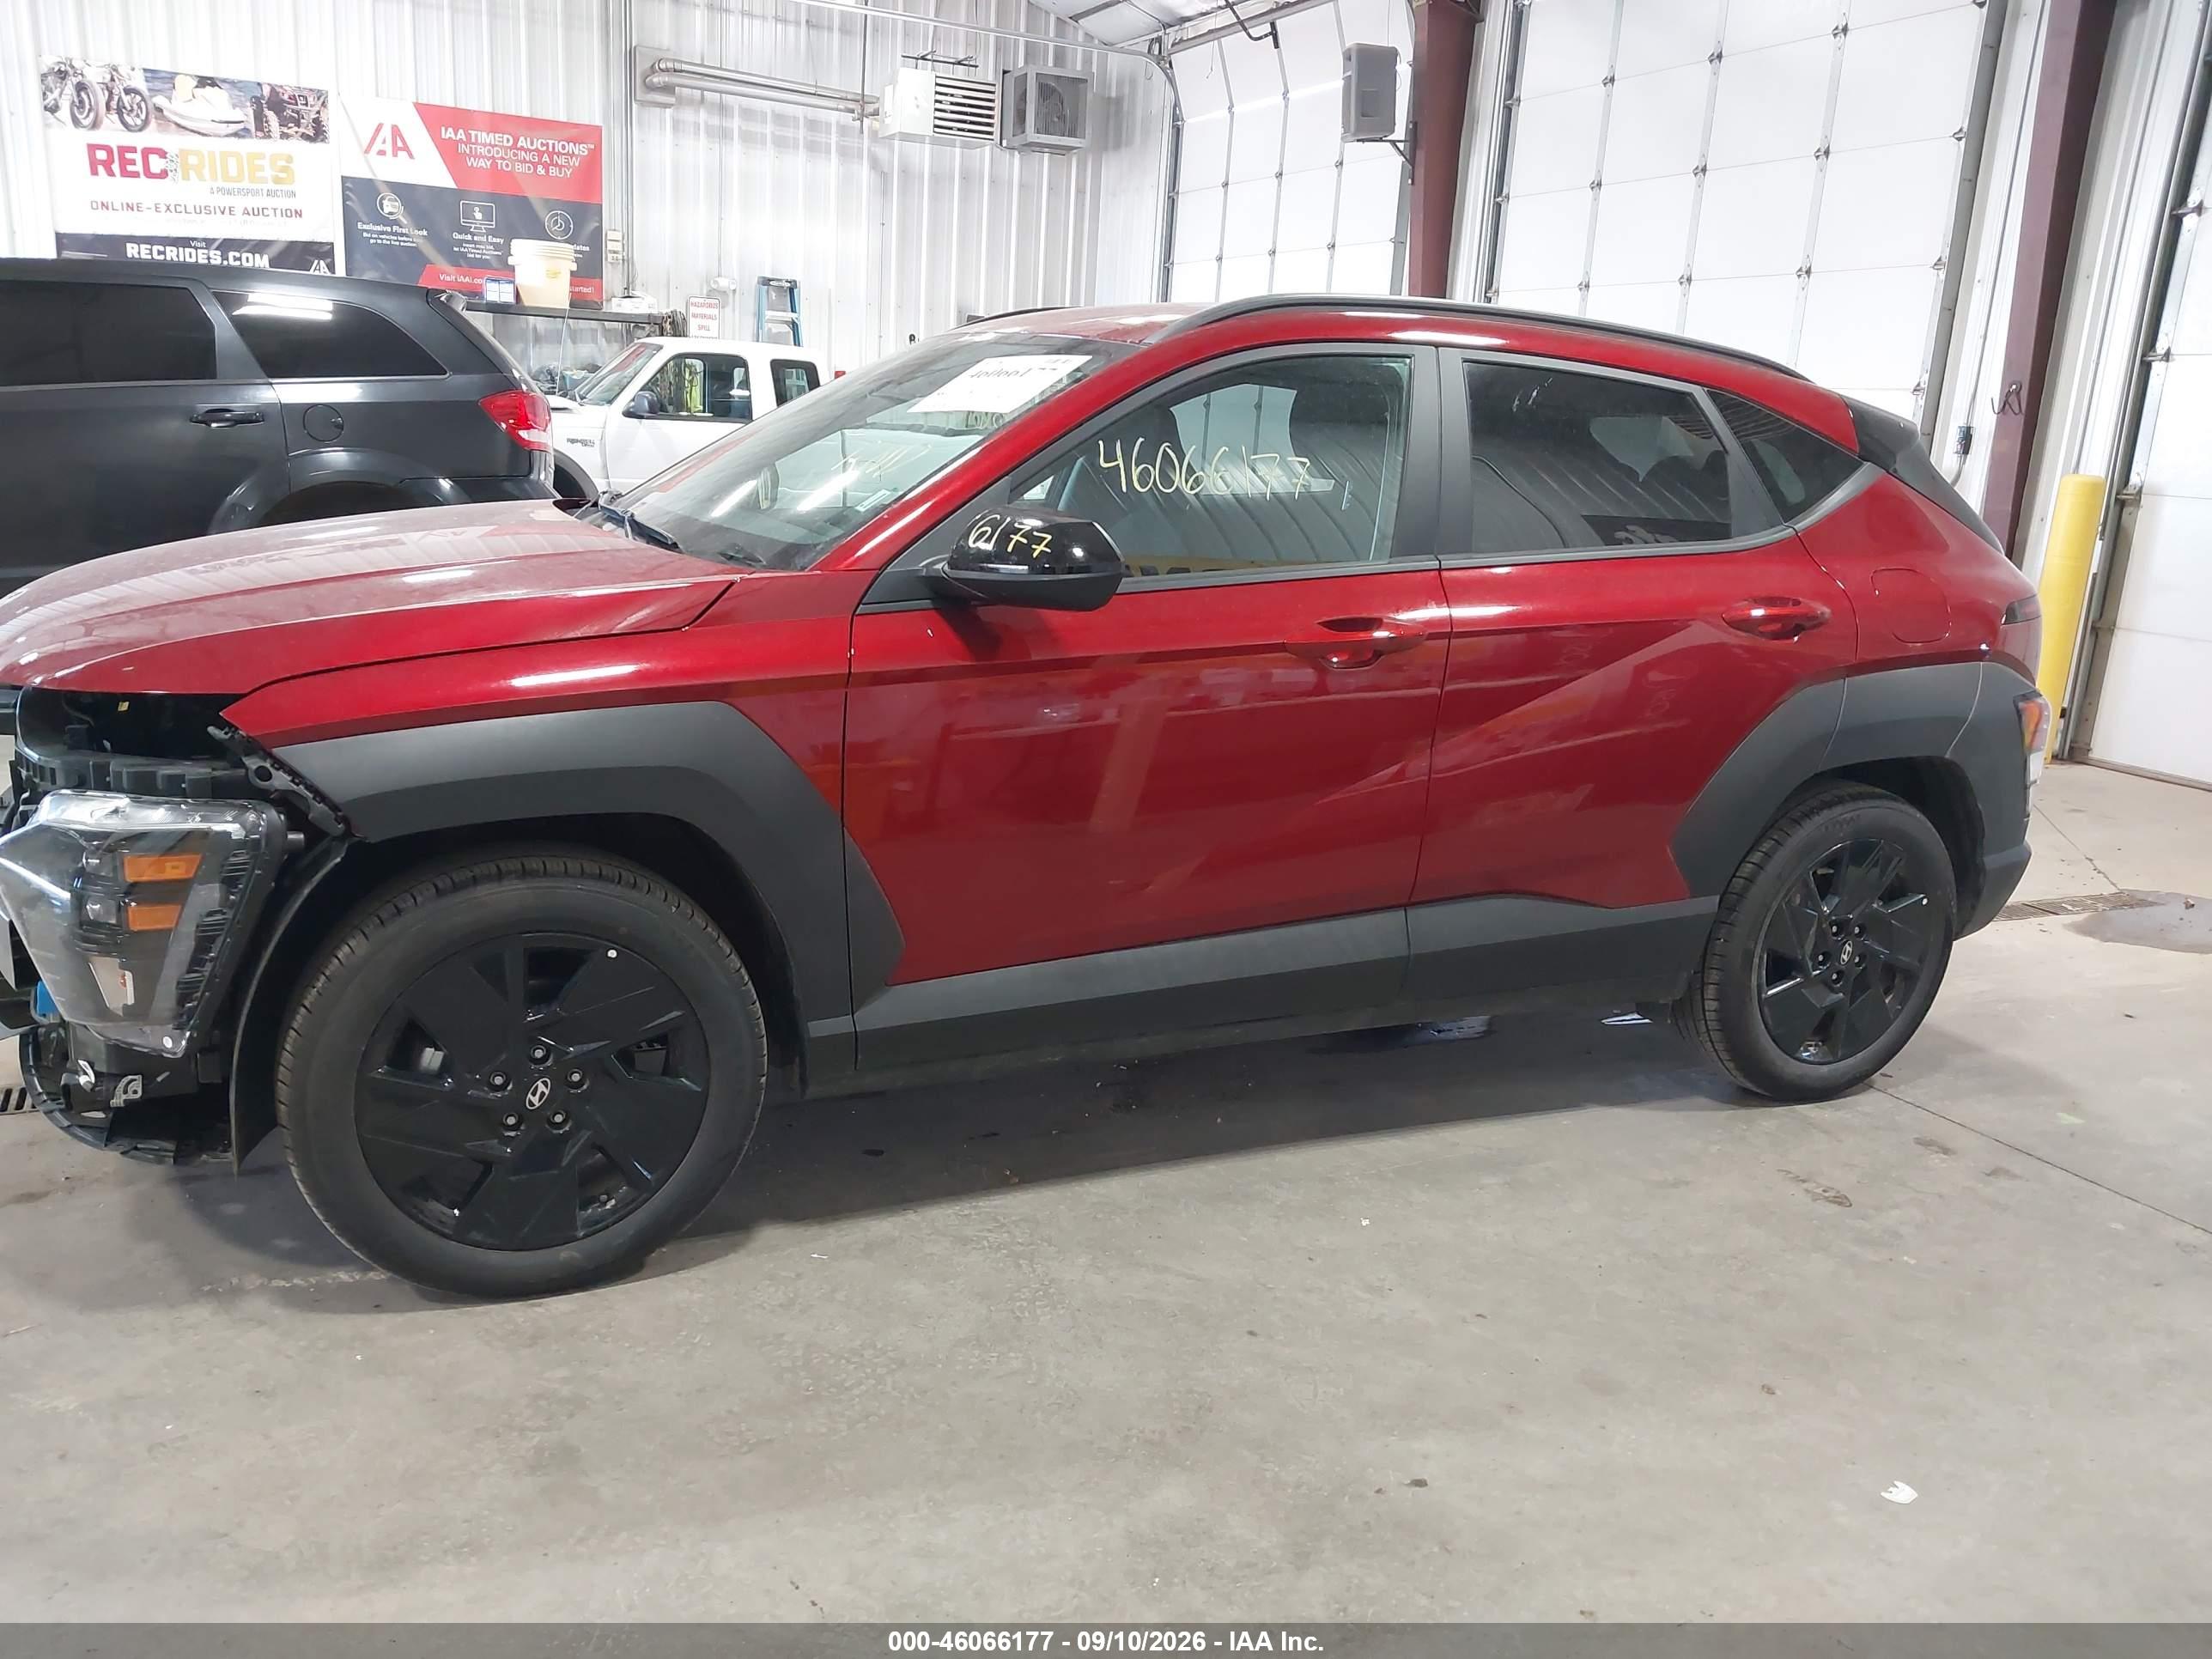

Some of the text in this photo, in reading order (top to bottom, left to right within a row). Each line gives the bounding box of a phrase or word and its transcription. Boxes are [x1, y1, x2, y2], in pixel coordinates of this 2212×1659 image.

[441, 126, 466, 142] IAA
[468, 130, 514, 147] TIMED
[86, 143, 295, 185] REC RIDES
[458, 143, 580, 167] INTRODUCING A NEW
[466, 156, 573, 178] WAY TO BID & BUY
[210, 186, 296, 198] A POWERSPORT AUCTION
[90, 199, 303, 219] ONLINE-EXCLUSIVE AUCTION
[357, 222, 428, 236] Exclusive First Look
[453, 232, 504, 245] Quick and Easy
[190, 240, 207, 248] Visit
[125, 242, 270, 269] RECRIDES.COM
[439, 273, 456, 283] Visit
[1097, 436, 1311, 501] 46066177
[968, 514, 1053, 559] 6177
